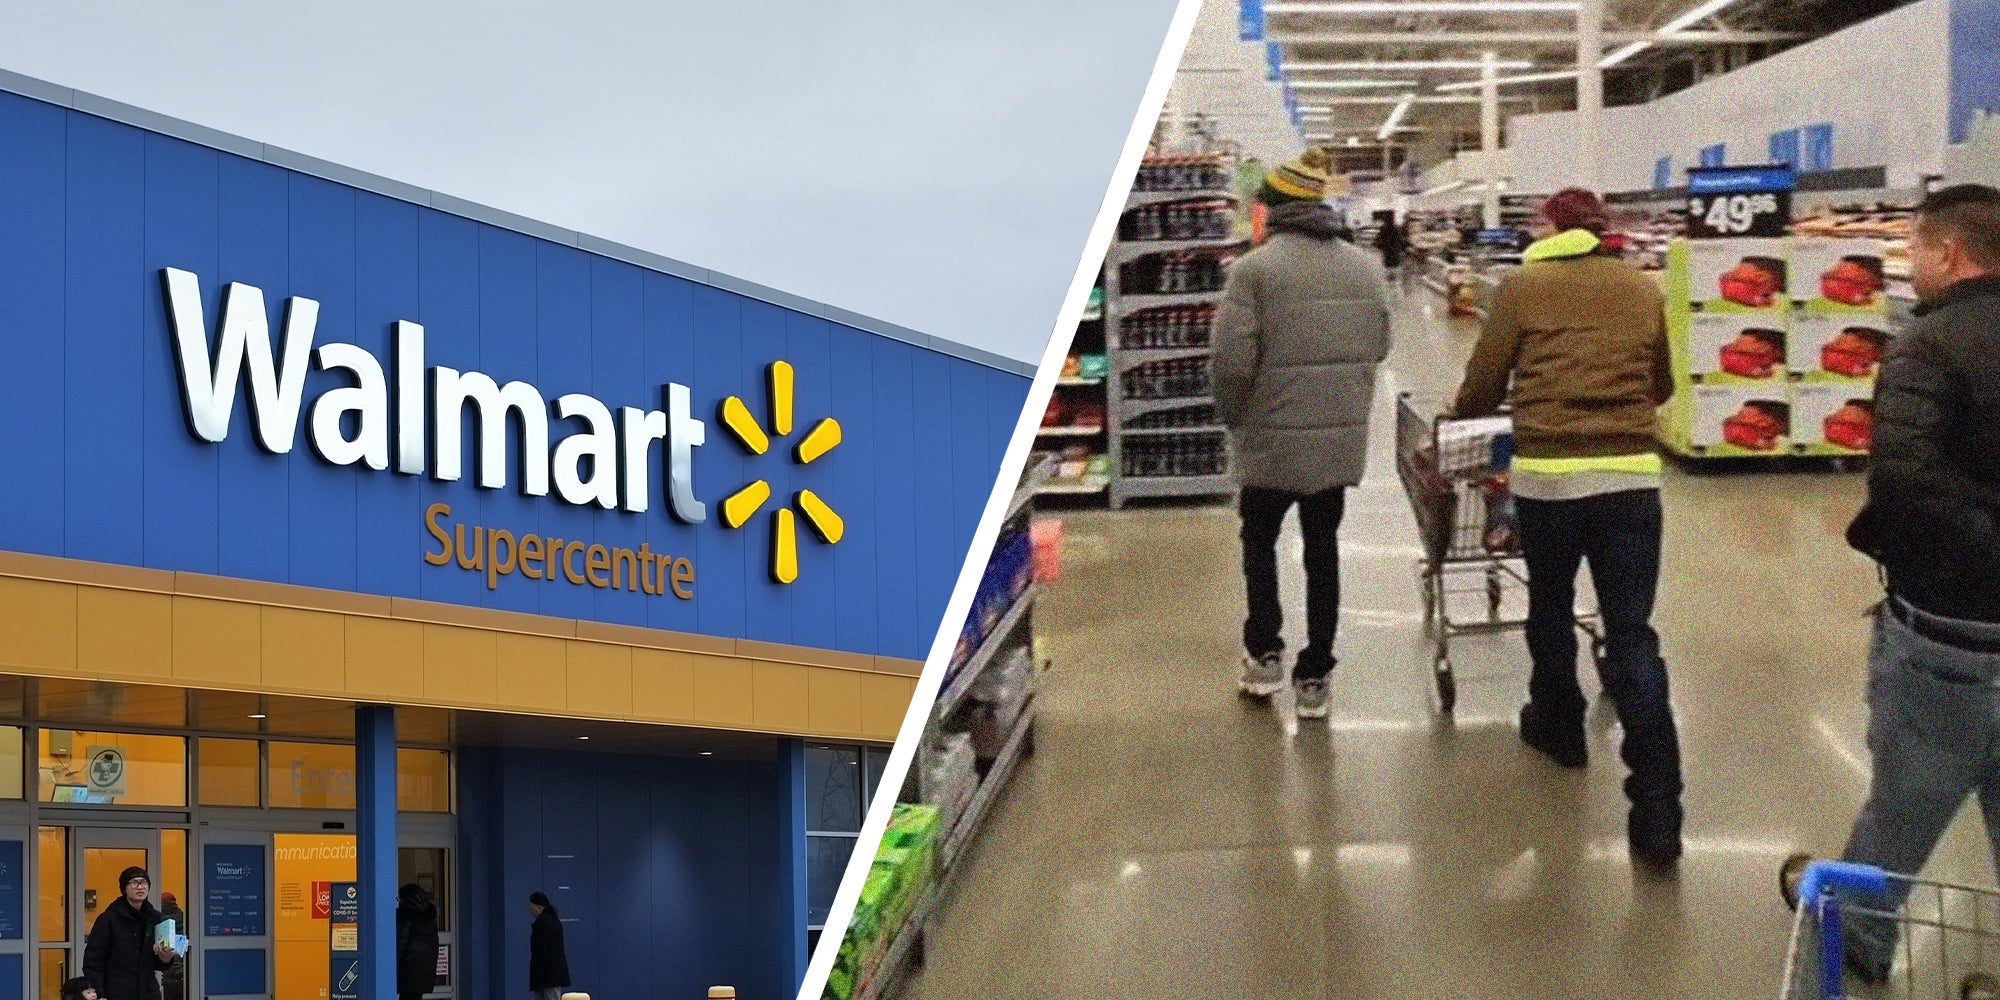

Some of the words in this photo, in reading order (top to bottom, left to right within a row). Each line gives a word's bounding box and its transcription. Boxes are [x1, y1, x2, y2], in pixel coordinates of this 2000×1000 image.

[159, 266, 706, 524] Walmart
[424, 502, 694, 599] Supercentre
[217, 867, 243, 875] Walmart
